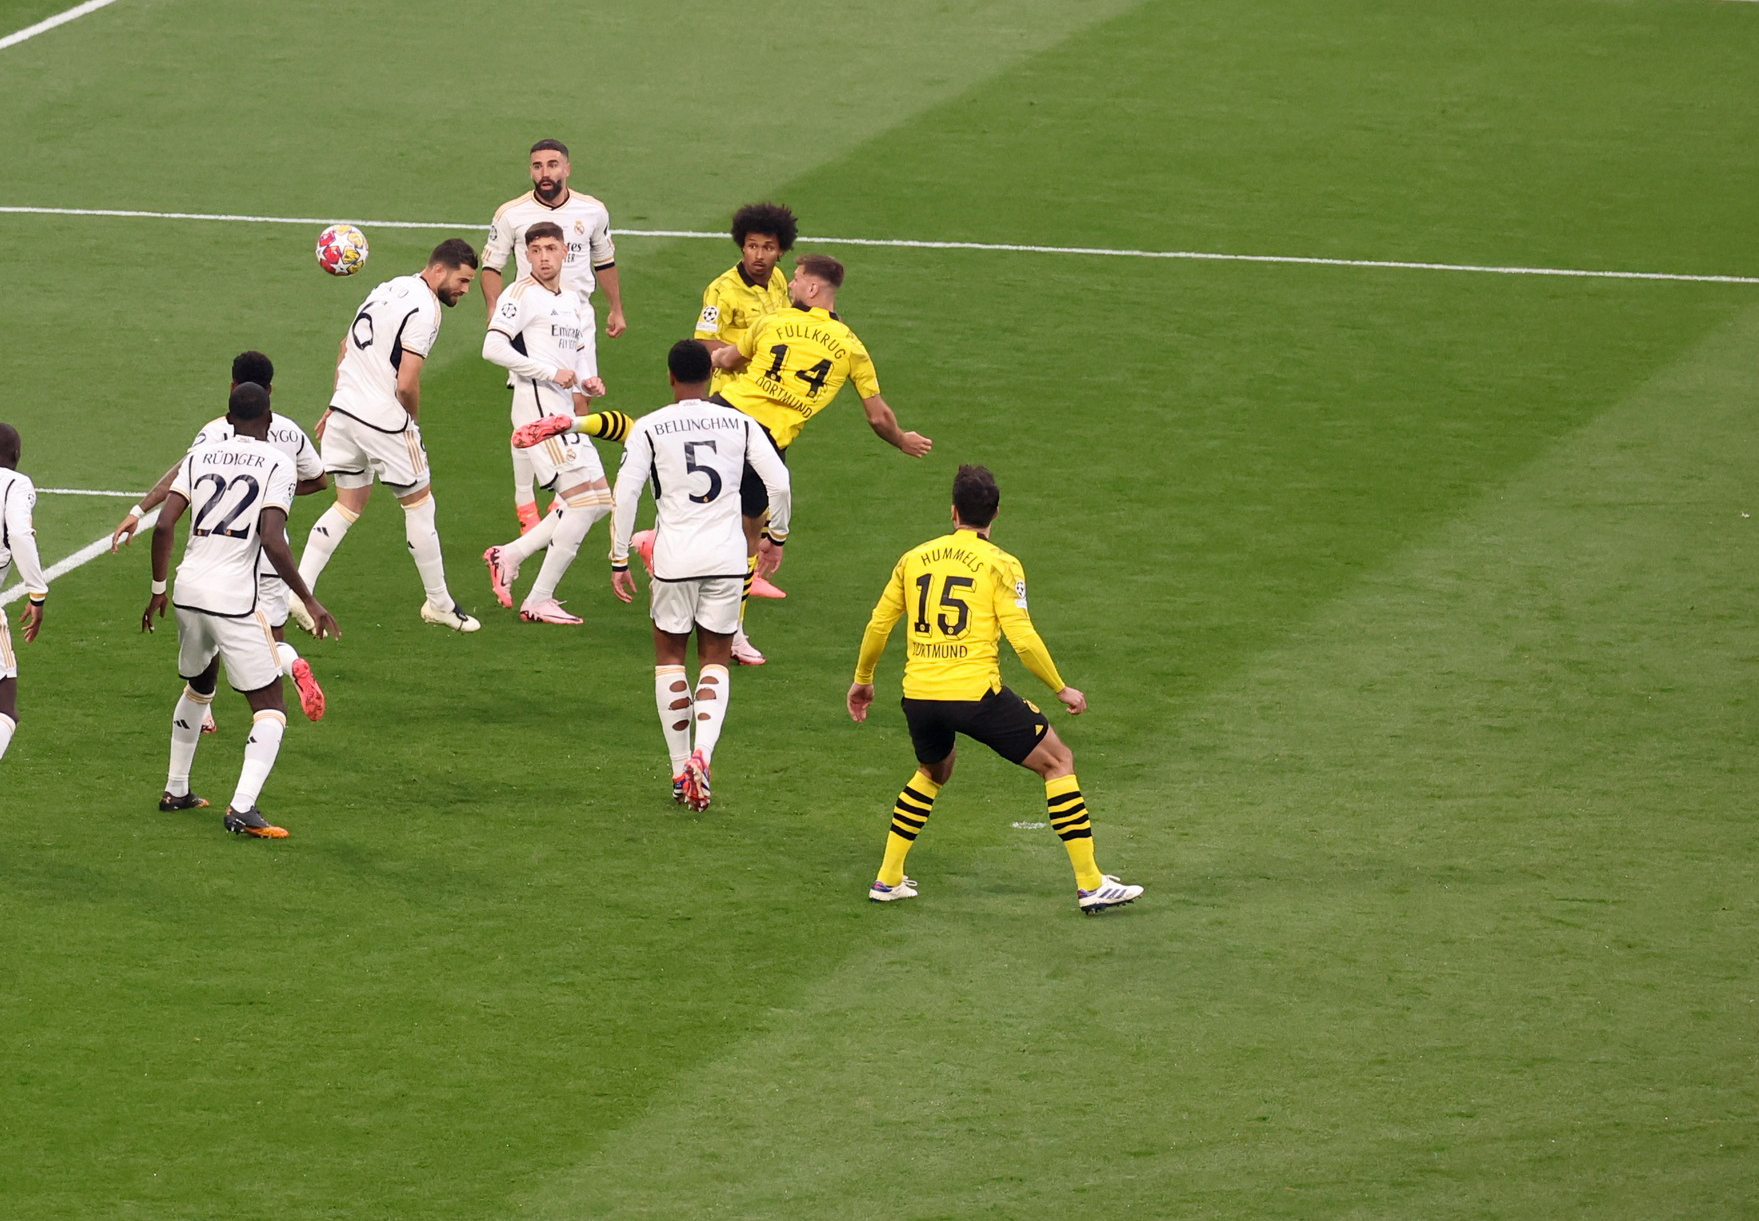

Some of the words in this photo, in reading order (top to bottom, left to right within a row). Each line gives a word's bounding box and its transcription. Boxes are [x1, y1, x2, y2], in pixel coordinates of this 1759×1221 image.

[776, 323, 846, 360] FÜLLKRUG
[764, 344, 834, 401] 14
[755, 376, 812, 419] DORTMUND
[654, 417, 739, 436] BELLINGHAM
[202, 450, 266, 468] RÜDIGER
[684, 440, 722, 504] 5
[193, 473, 260, 539] 22
[921, 547, 984, 573] HUMMELS
[914, 573, 976, 639] 15
